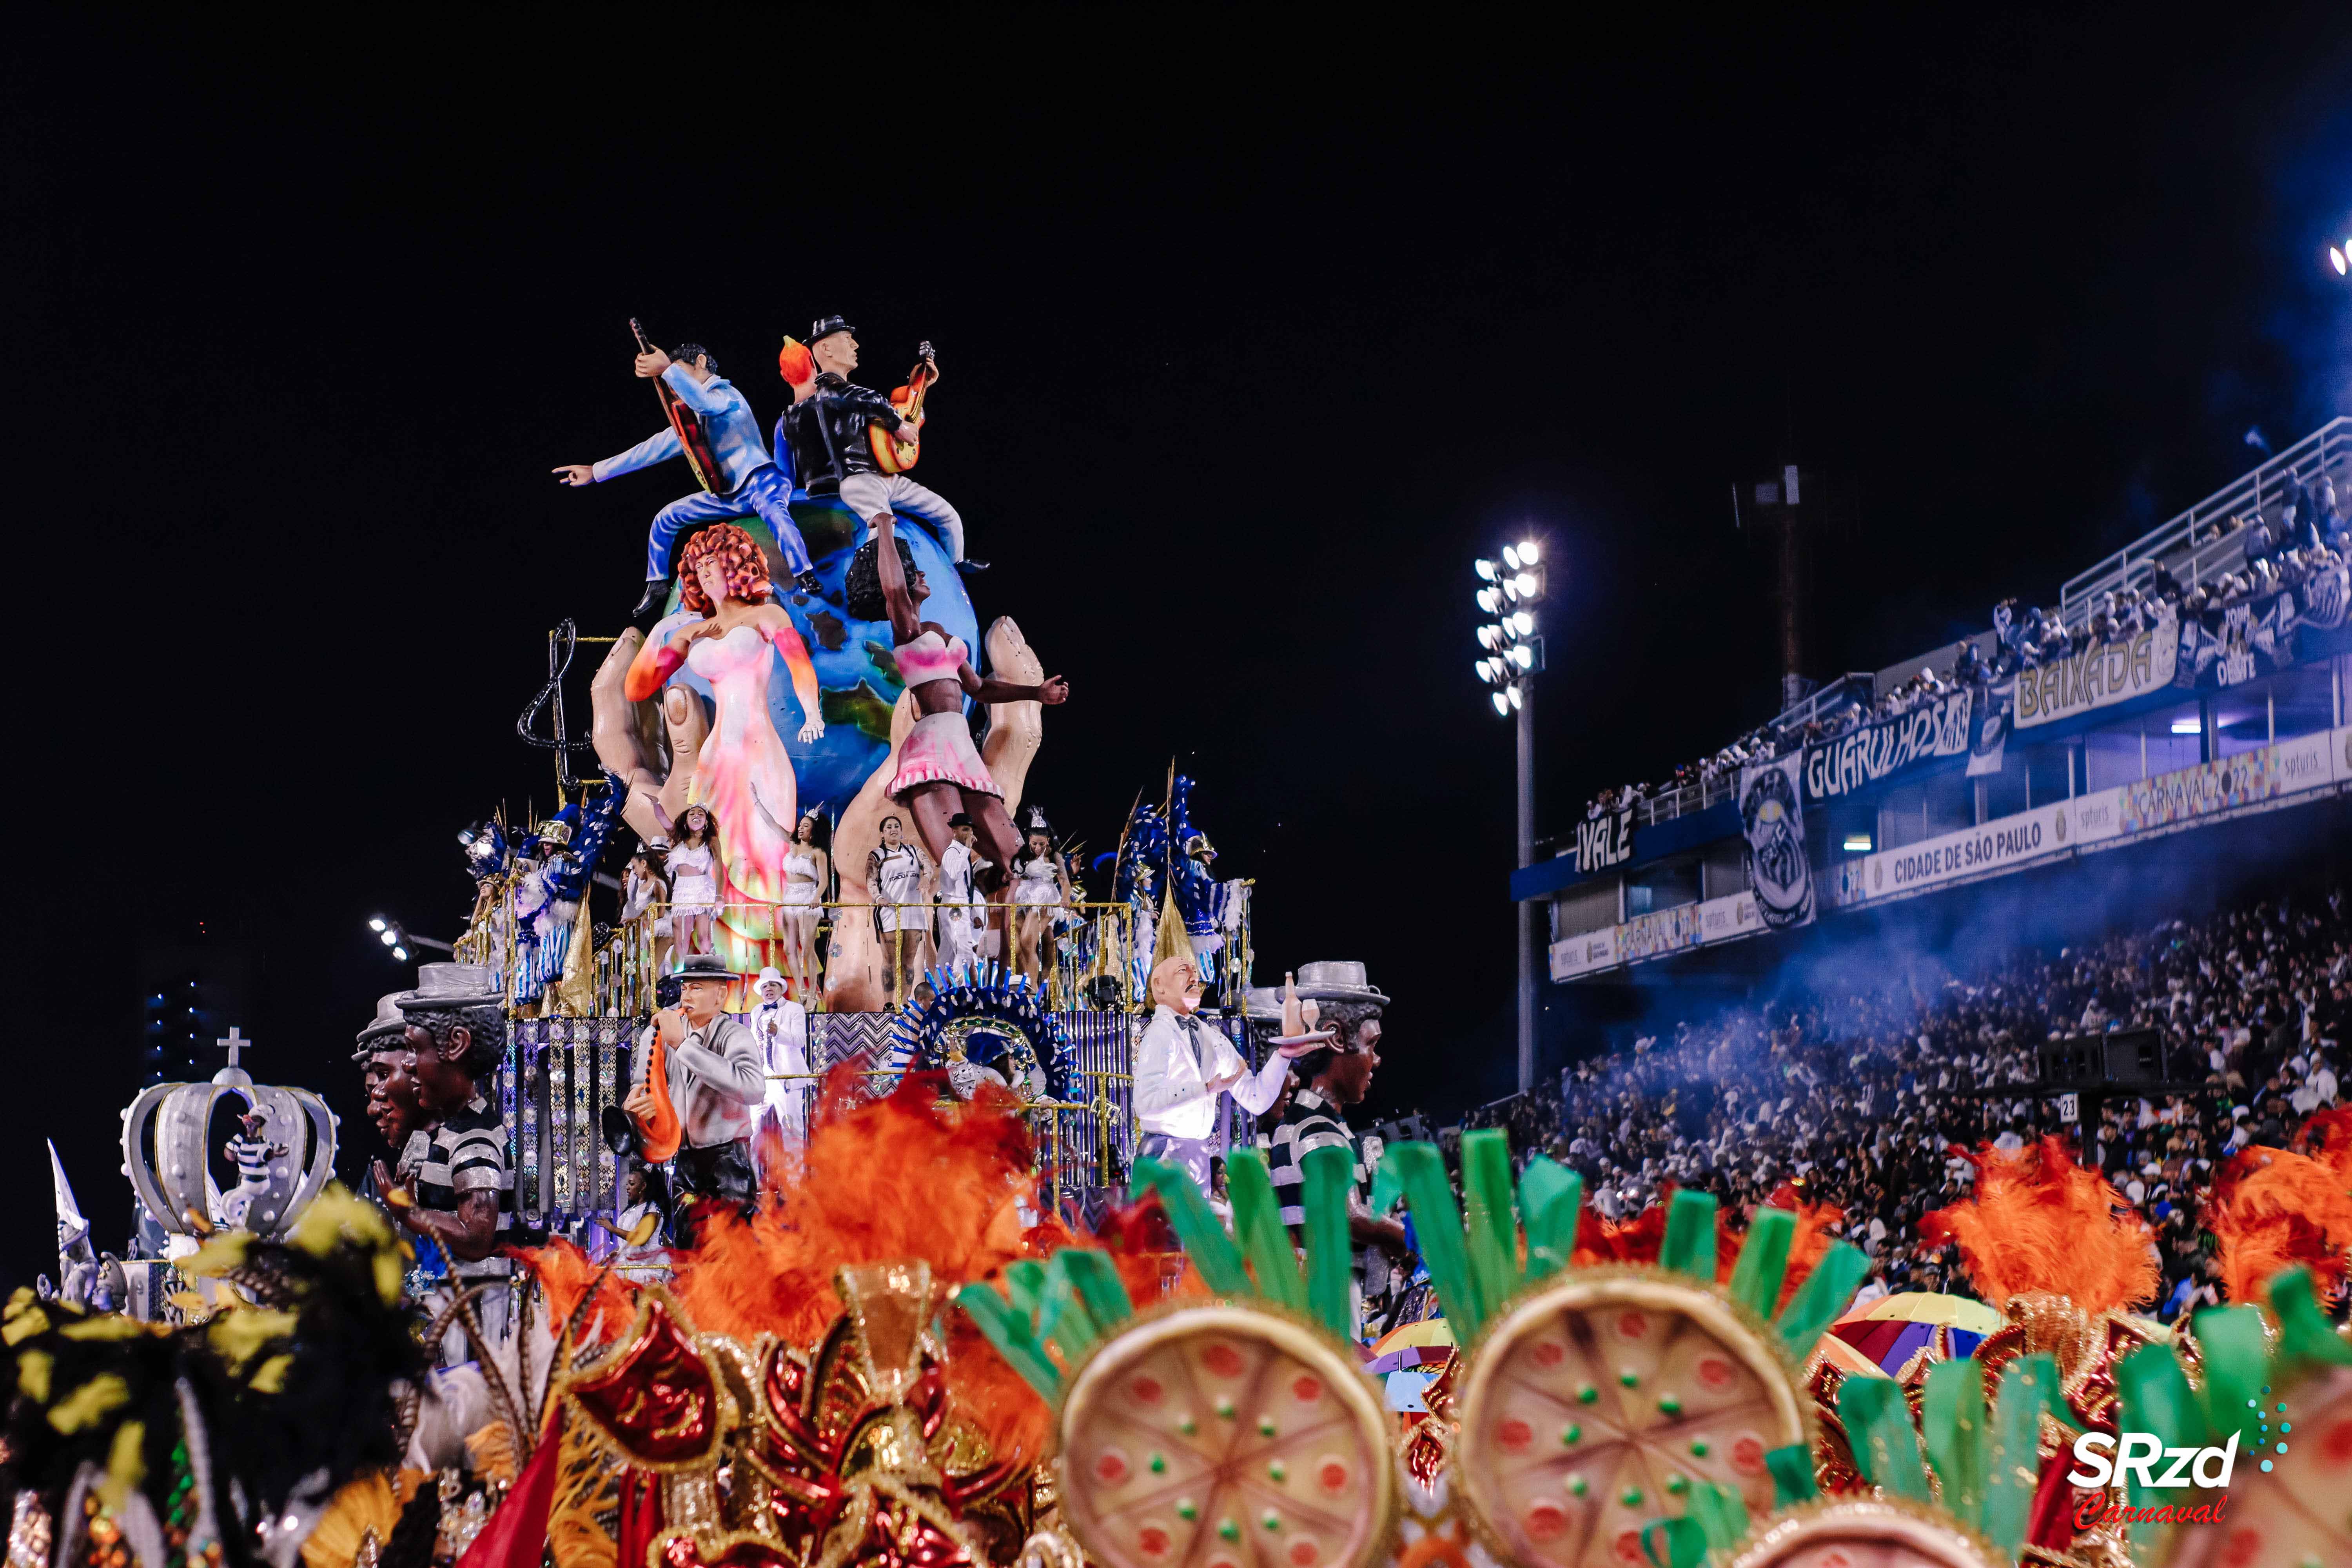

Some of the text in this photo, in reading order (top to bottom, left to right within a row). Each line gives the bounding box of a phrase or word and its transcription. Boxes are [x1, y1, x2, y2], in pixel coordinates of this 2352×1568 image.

[2020, 630, 2153, 719] BAIXADA
[1808, 701, 1946, 797] GUARULHOS
[2140, 774, 2209, 814] CARNAVAL
[1895, 822, 2042, 884] CIDADE DE SÃO PAULO
[2063, 1100, 2075, 1116] 23
